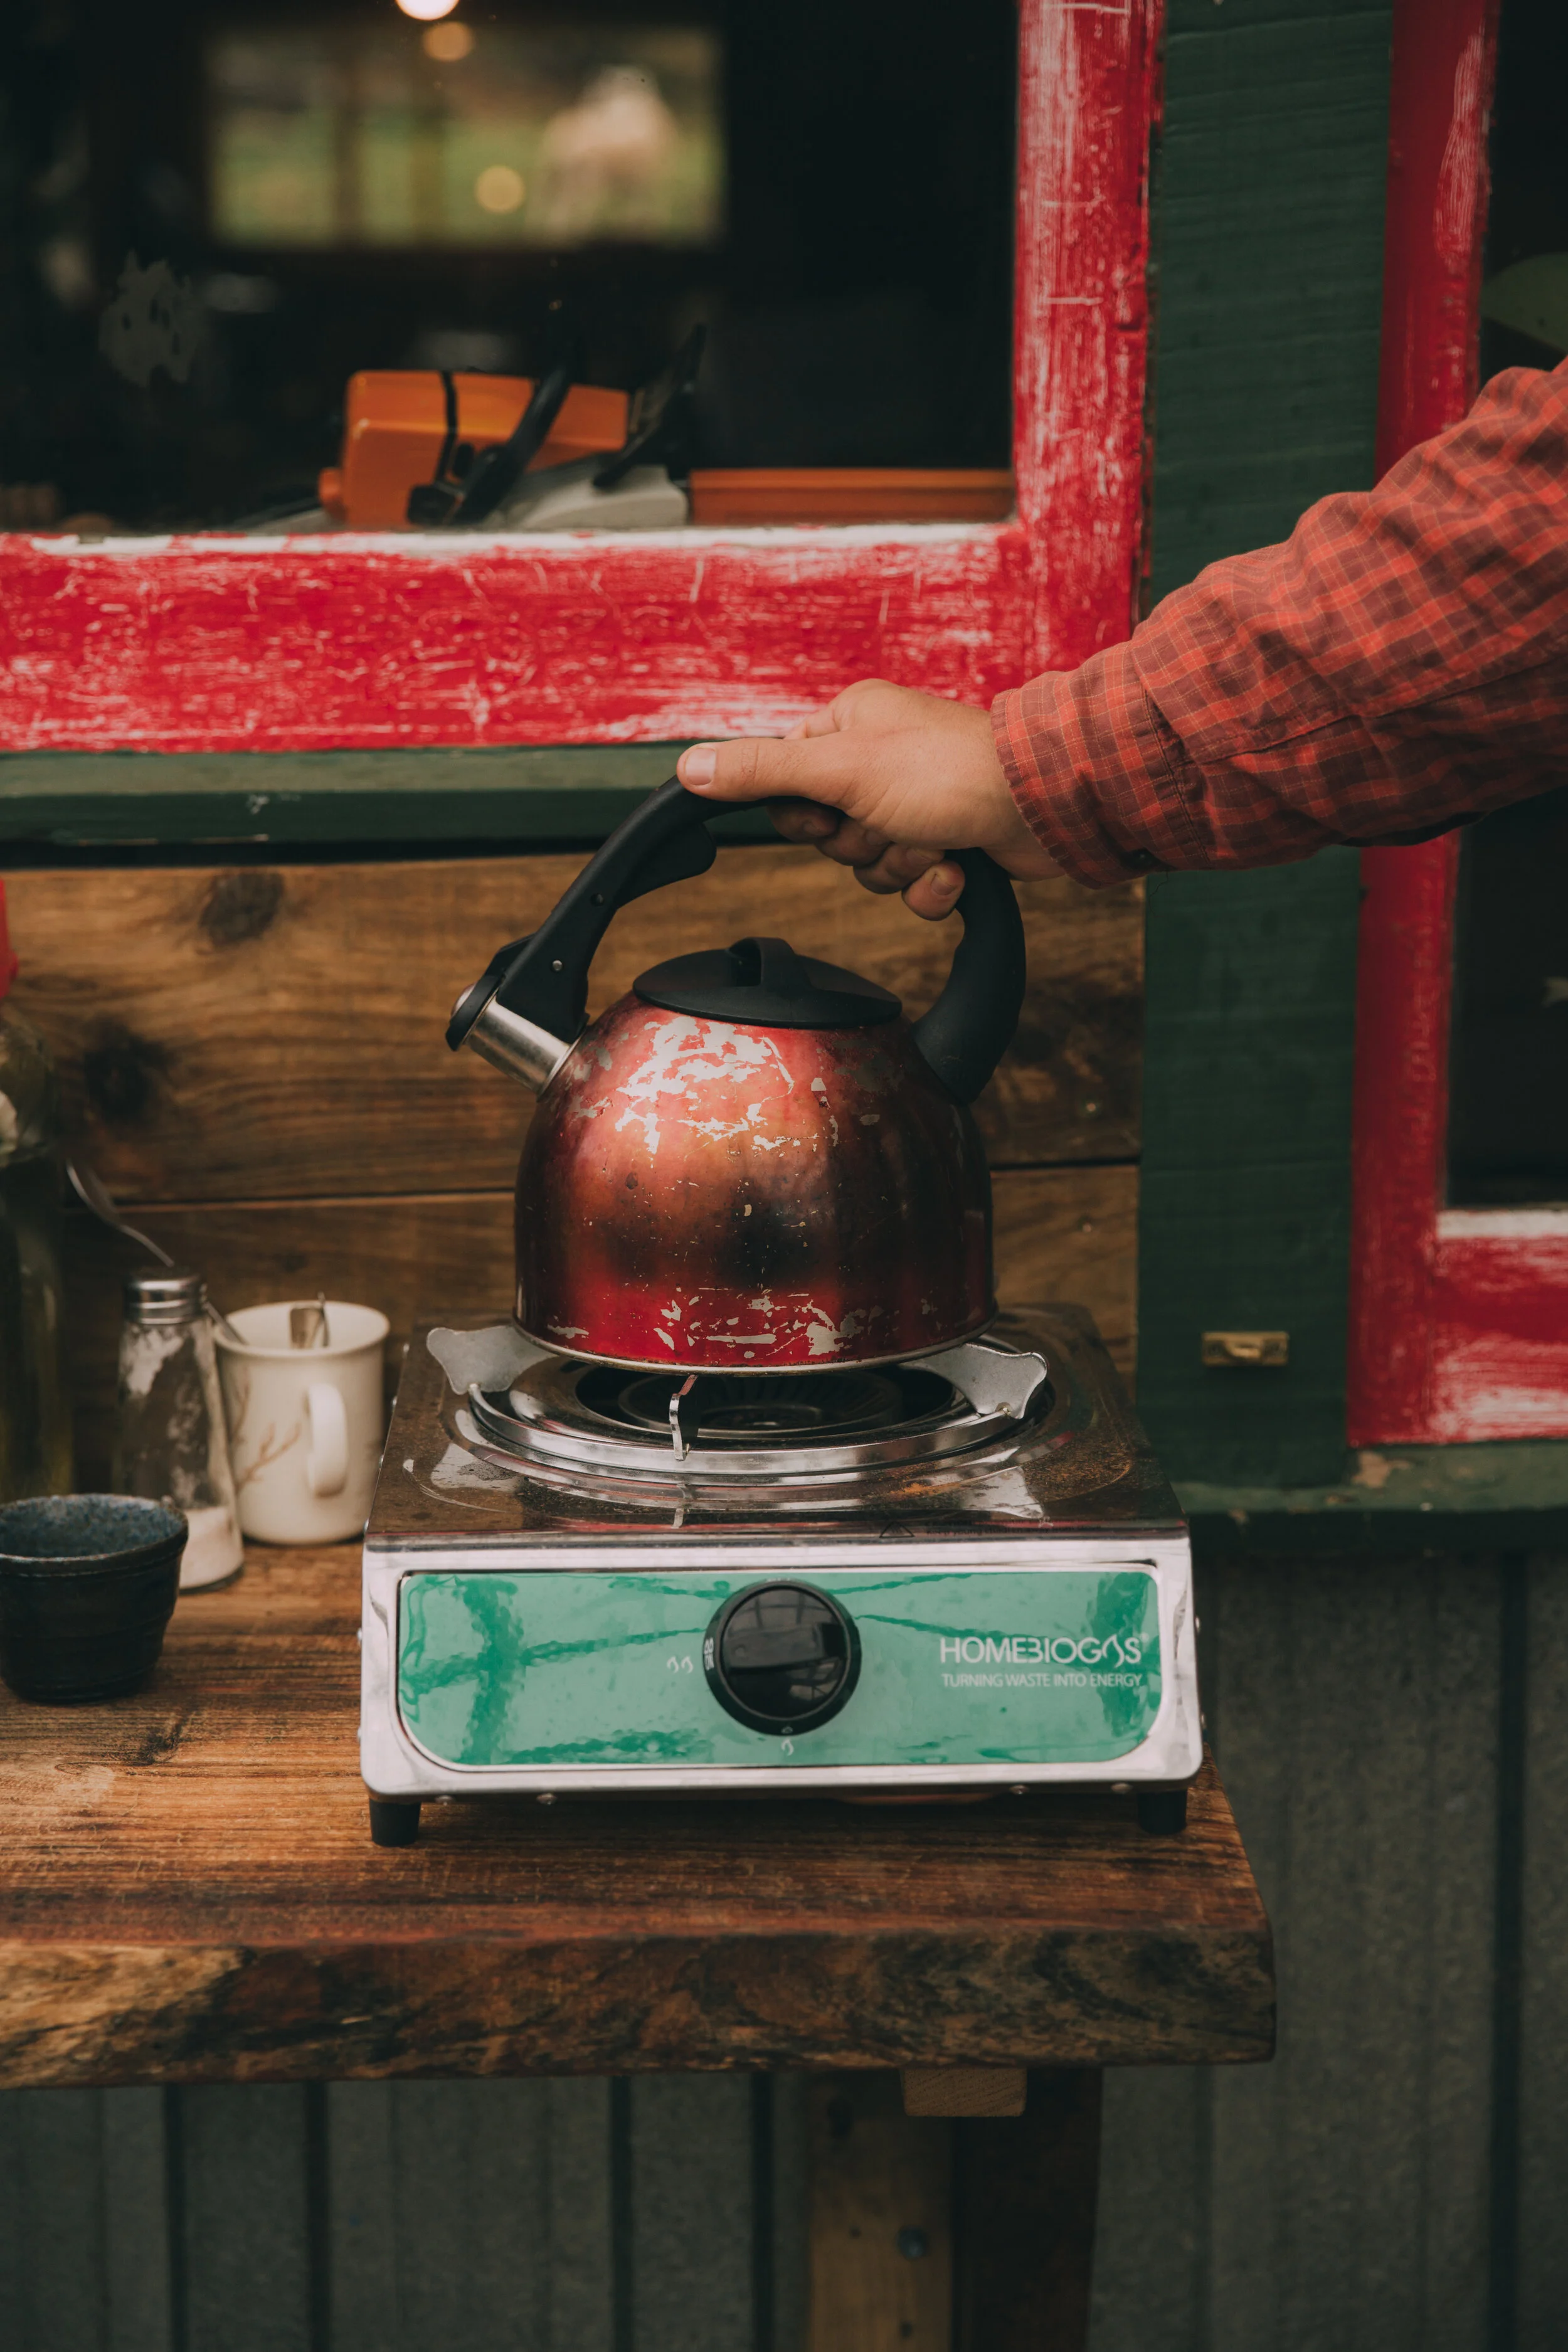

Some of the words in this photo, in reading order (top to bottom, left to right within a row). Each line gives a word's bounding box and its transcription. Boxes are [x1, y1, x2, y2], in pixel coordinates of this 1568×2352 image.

[940, 1634, 1142, 1668] HOMEBIOGAS
[942, 1673, 1004, 1687] TURNING
[1005, 1673, 1051, 1687] WASTE
[1054, 1673, 1086, 1687] INTO
[1091, 1673, 1142, 1687] ENERGY
